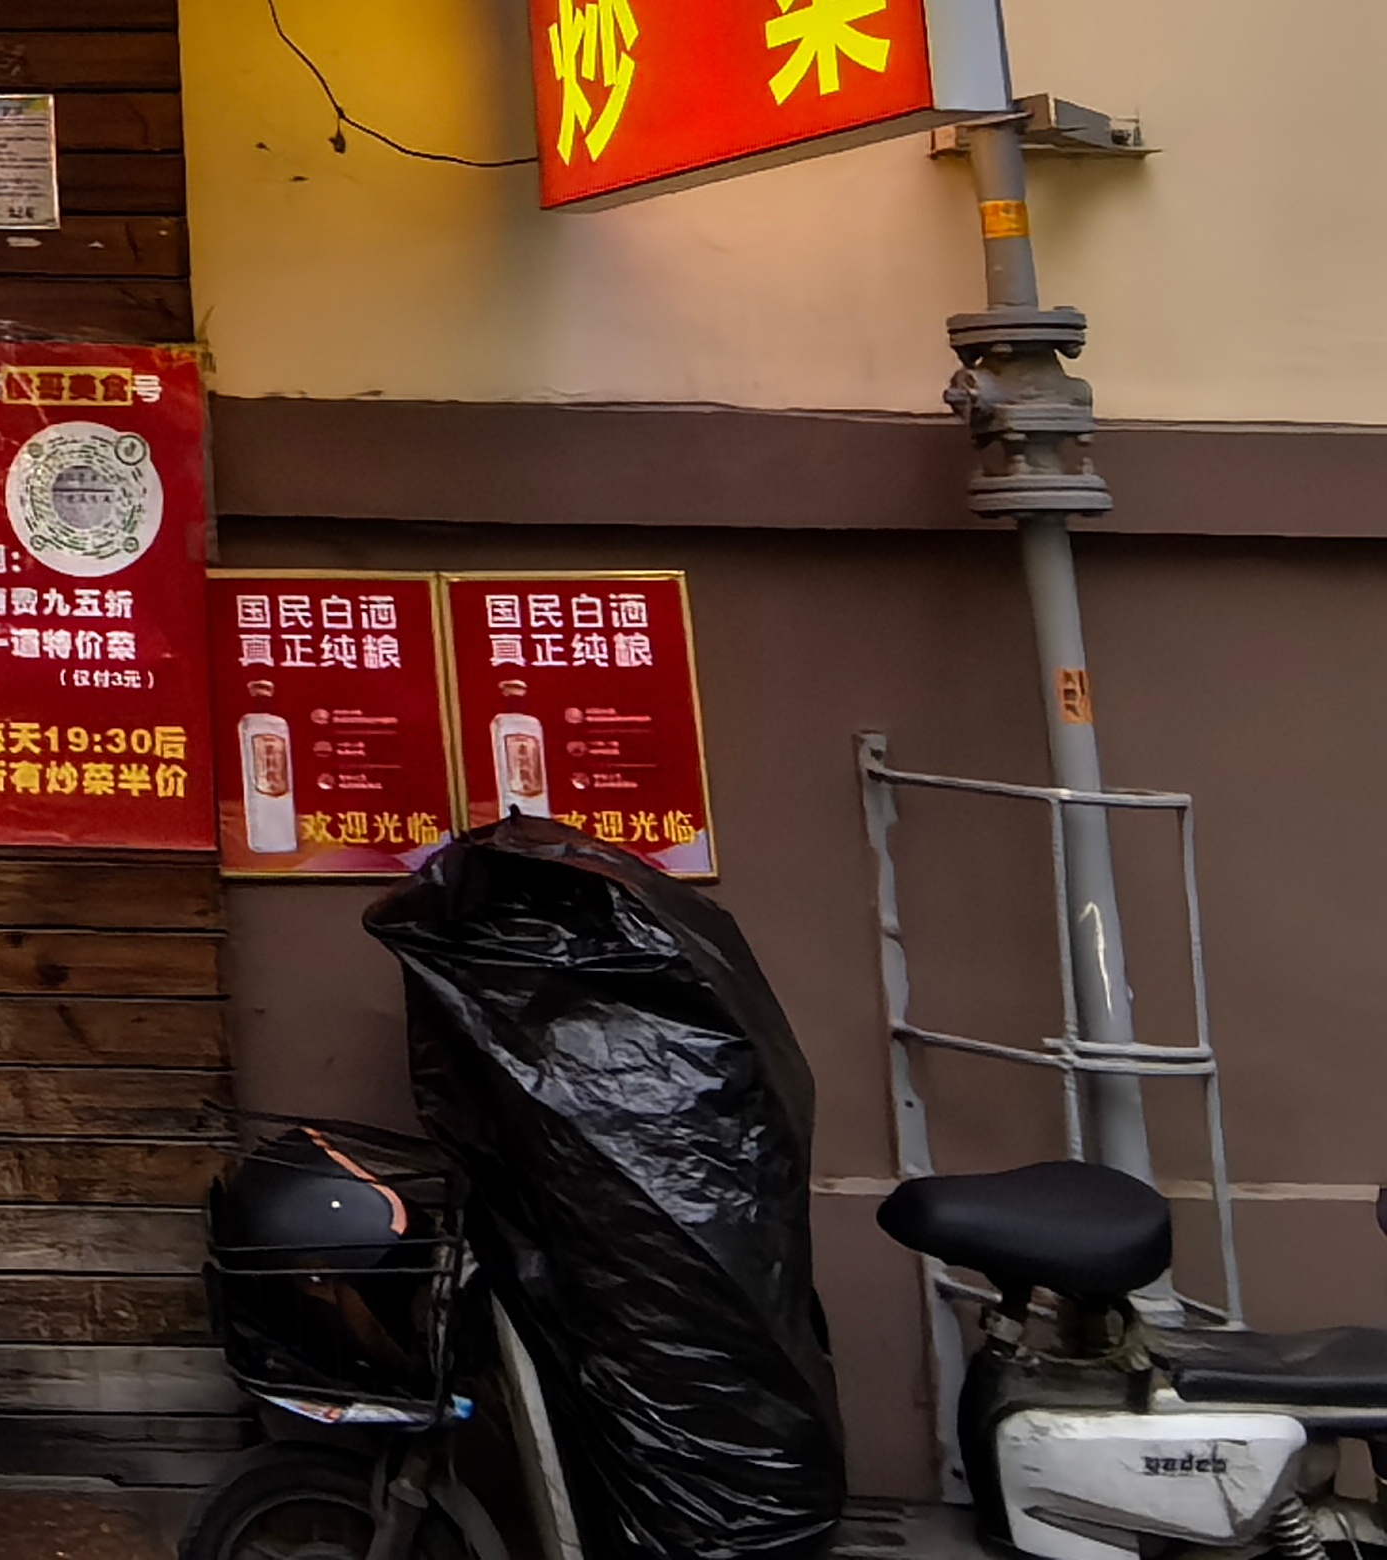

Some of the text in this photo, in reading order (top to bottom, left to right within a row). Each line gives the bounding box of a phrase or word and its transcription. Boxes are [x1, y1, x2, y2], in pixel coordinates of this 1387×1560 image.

[235, 593, 398, 630] 国民白酒
[484, 592, 649, 629] 国民白酒
[238, 633, 402, 670] 真正纯粮
[488, 631, 654, 668] 真正纯粮
[300, 810, 441, 845] 欢迎光临
